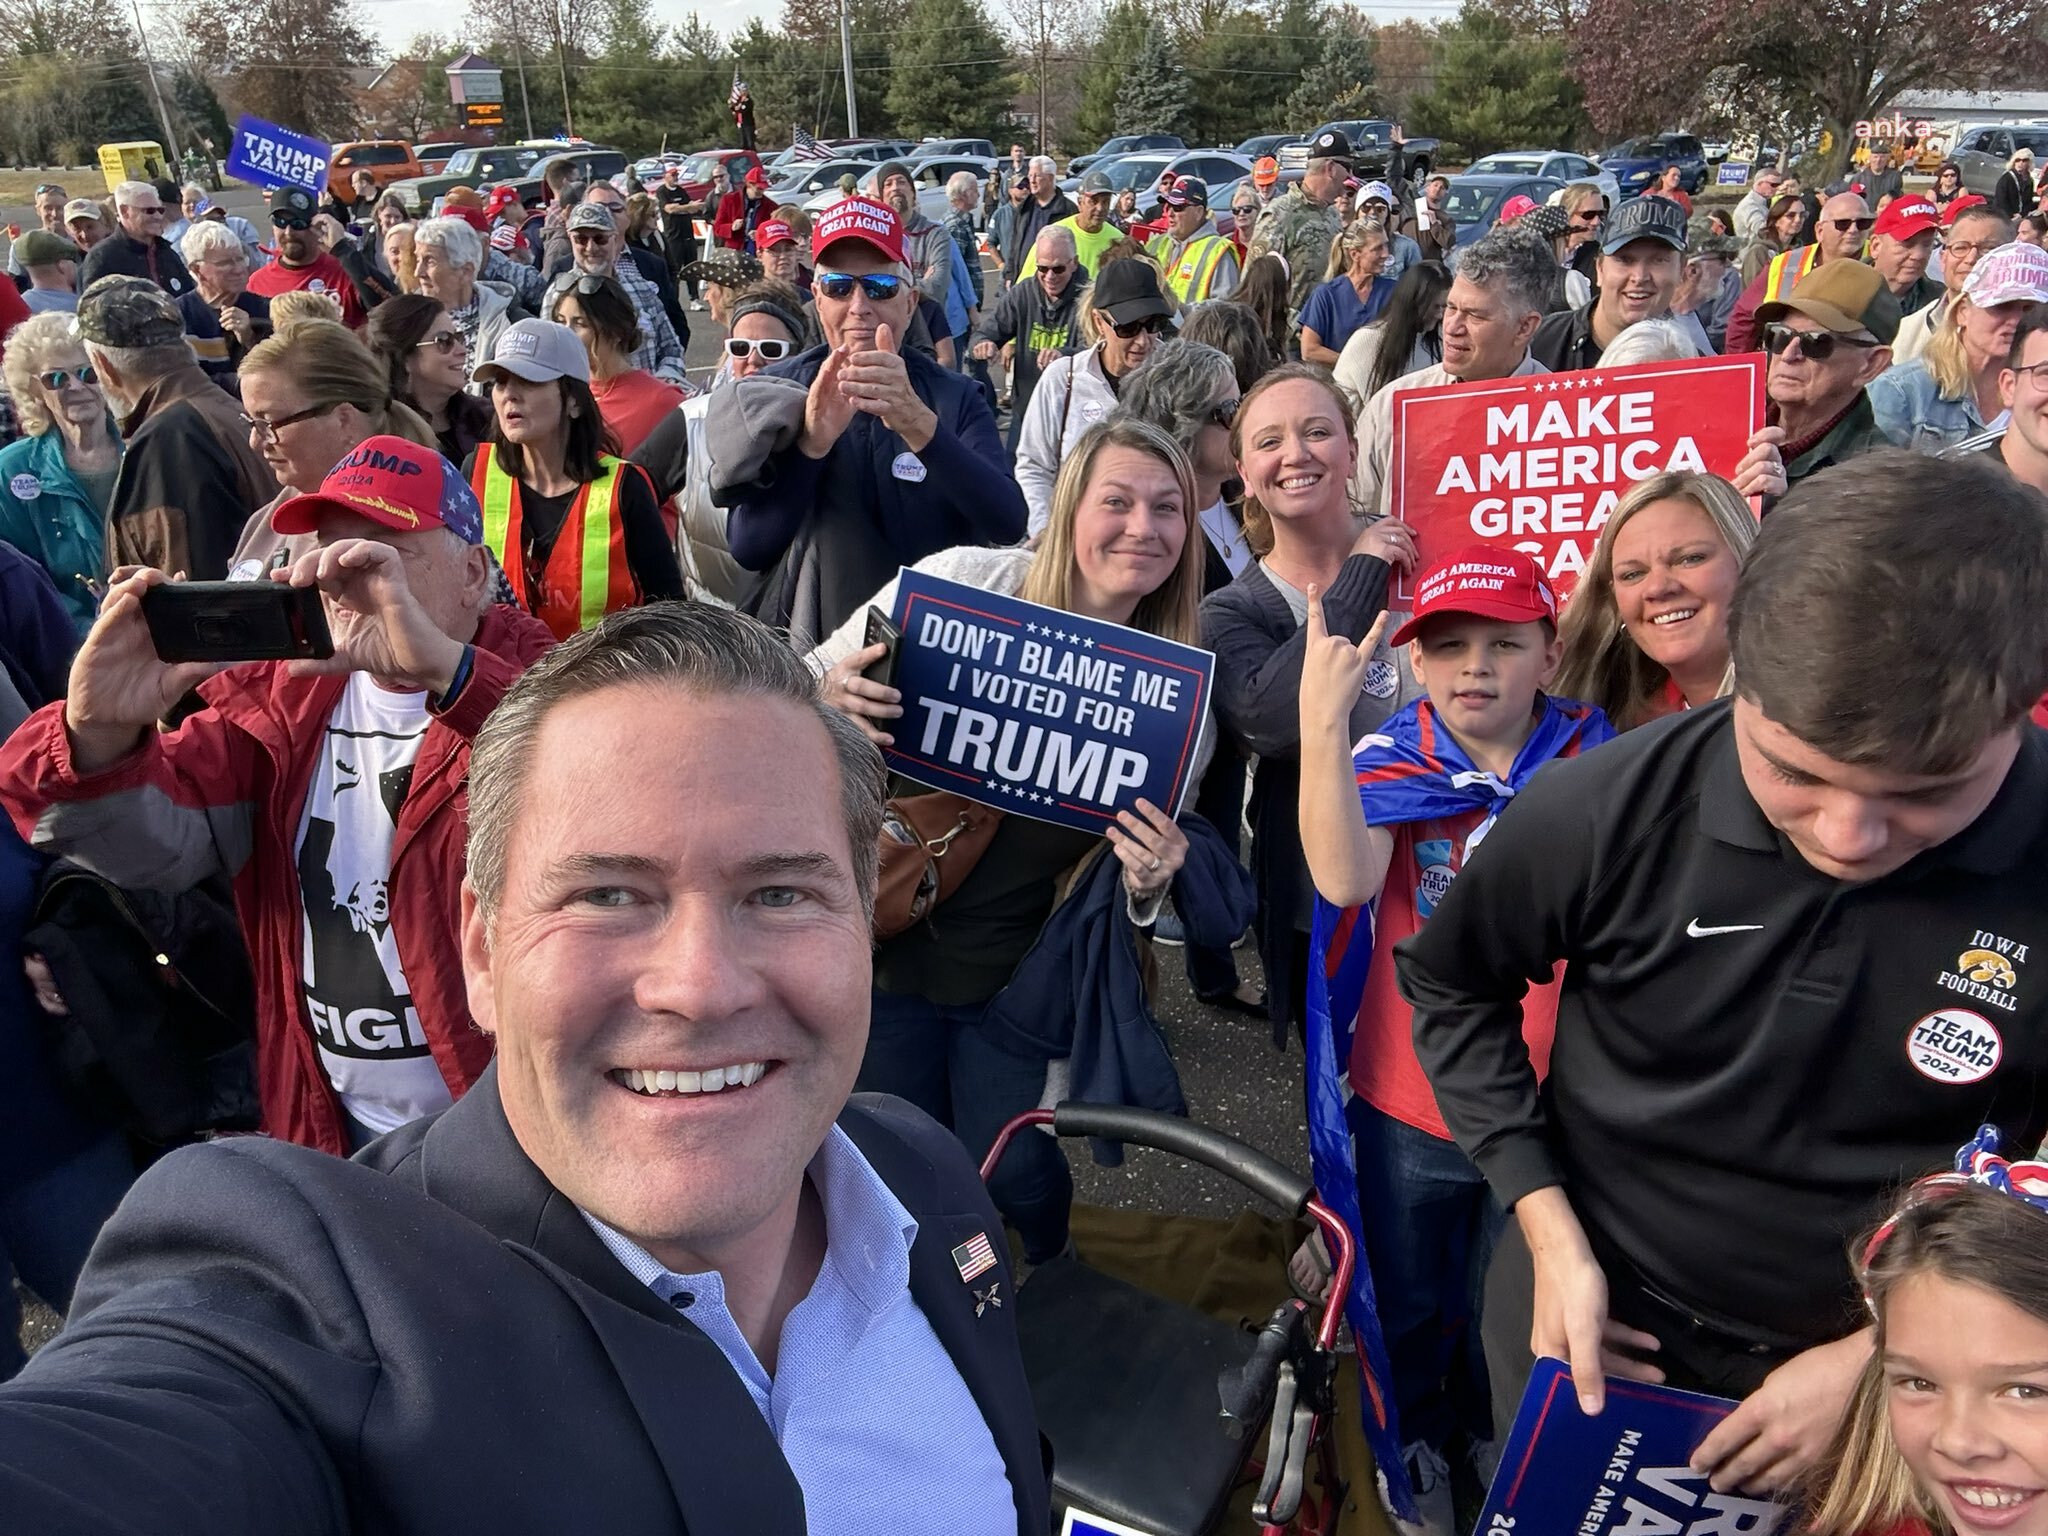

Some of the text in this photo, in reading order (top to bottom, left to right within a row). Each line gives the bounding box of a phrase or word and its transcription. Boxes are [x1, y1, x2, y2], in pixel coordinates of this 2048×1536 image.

[243, 131, 327, 174] TRUMP
[248, 149, 317, 185] VANCE
[1720, 169, 1747, 177] TRUMP
[817, 200, 896, 227] MAKE AMERICA
[820, 215, 890, 238] GREAT AGAIN
[1612, 201, 1684, 232] TRUMP
[1486, 391, 1655, 446] MAKE
[337, 474, 374, 486] 2024
[1435, 436, 1708, 495] AMERICA
[1469, 489, 1620, 538] GREA
[1420, 563, 1517, 592] MAKE AMERICA
[1420, 577, 1504, 605] GREAT AGAIN
[918, 612, 1182, 713] DON'T BLAME ME
[1365, 662, 1388, 680] EAM
[947, 662, 1136, 737] I VOTED FOR
[1375, 682, 1394, 697] 2024
[918, 695, 1149, 807] TRUMP
[1421, 878, 1449, 892] TRU
[1430, 894, 1441, 903] 20
[1968, 929, 2030, 965] IOWA
[1936, 970, 2019, 1013] FOOTBALL
[1913, 1026, 1995, 1069] TRUMP
[1931, 1016, 1997, 1054] TEAM
[1919, 1054, 1961, 1078] 2024
[1603, 1429, 1643, 1483] MAKE
[1487, 1512, 1516, 1536] 20
